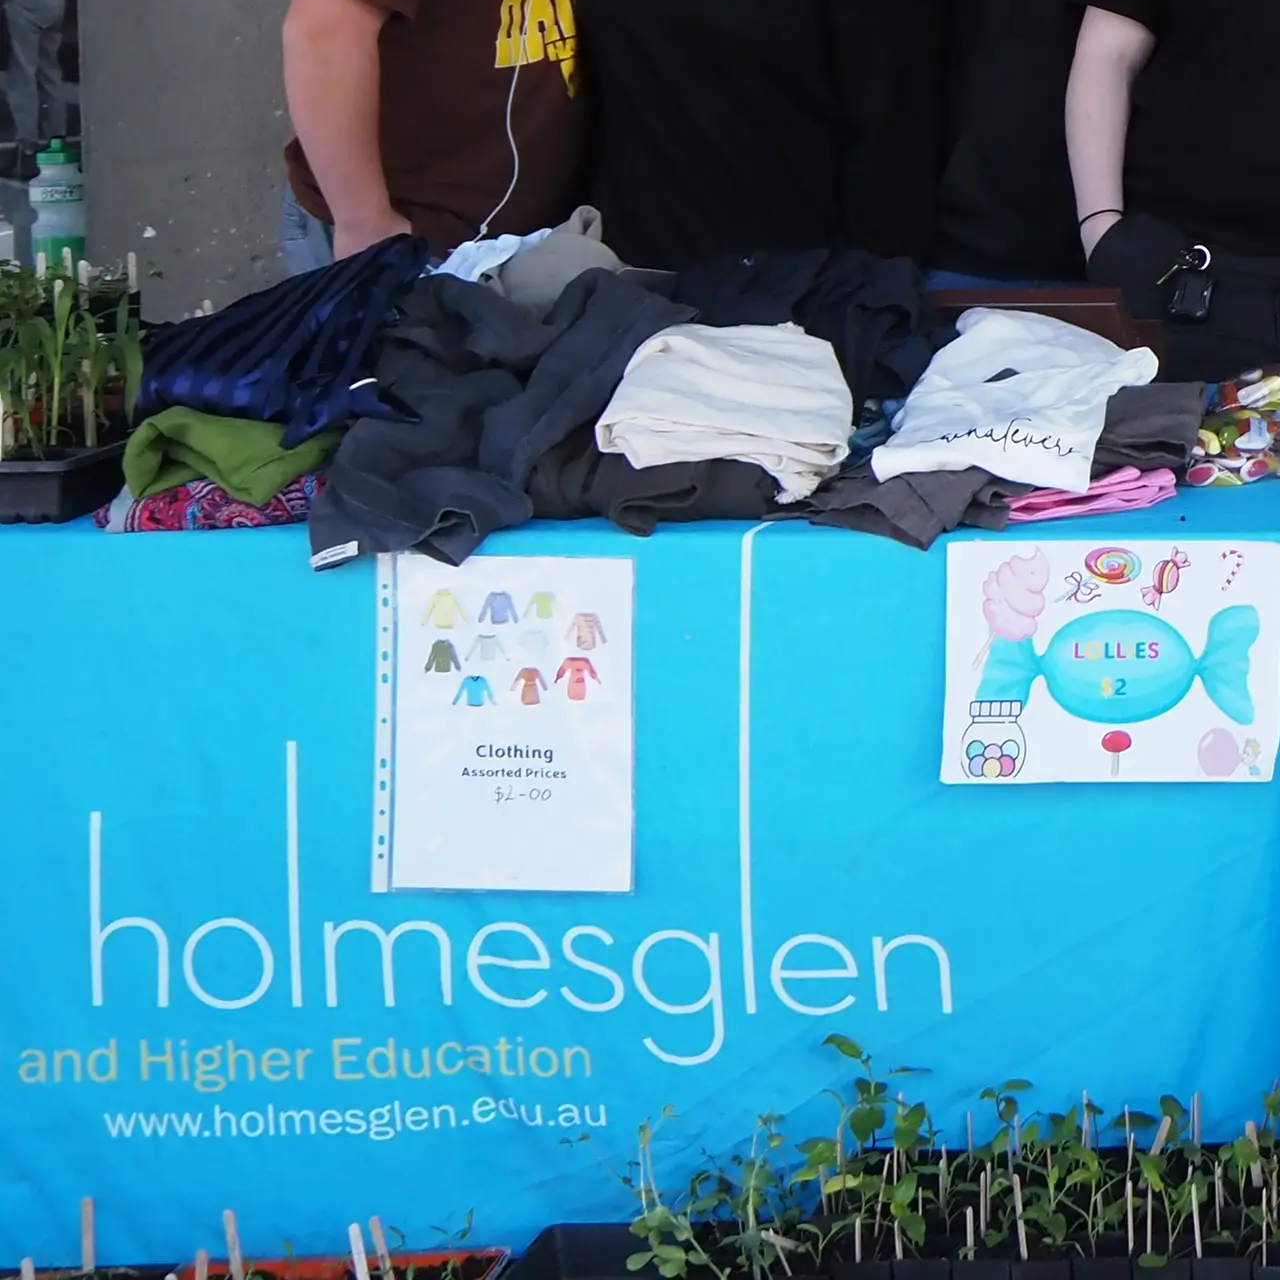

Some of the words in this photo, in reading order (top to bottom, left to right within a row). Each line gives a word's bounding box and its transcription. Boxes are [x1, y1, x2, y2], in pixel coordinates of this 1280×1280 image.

[1073, 641, 1160, 660] LOLLIES
[1101, 677, 1127, 698] $2
[475, 743, 555, 764] Clothing
[461, 766, 522, 778] Assorted
[525, 767, 567, 779] Prices
[89, 521, 953, 1066] holmesglen
[18, 1038, 118, 1085] and
[138, 1037, 313, 1093] Higher
[331, 1034, 593, 1082] Education
[104, 1094, 608, 1141] www.holmesglen.edu.au
